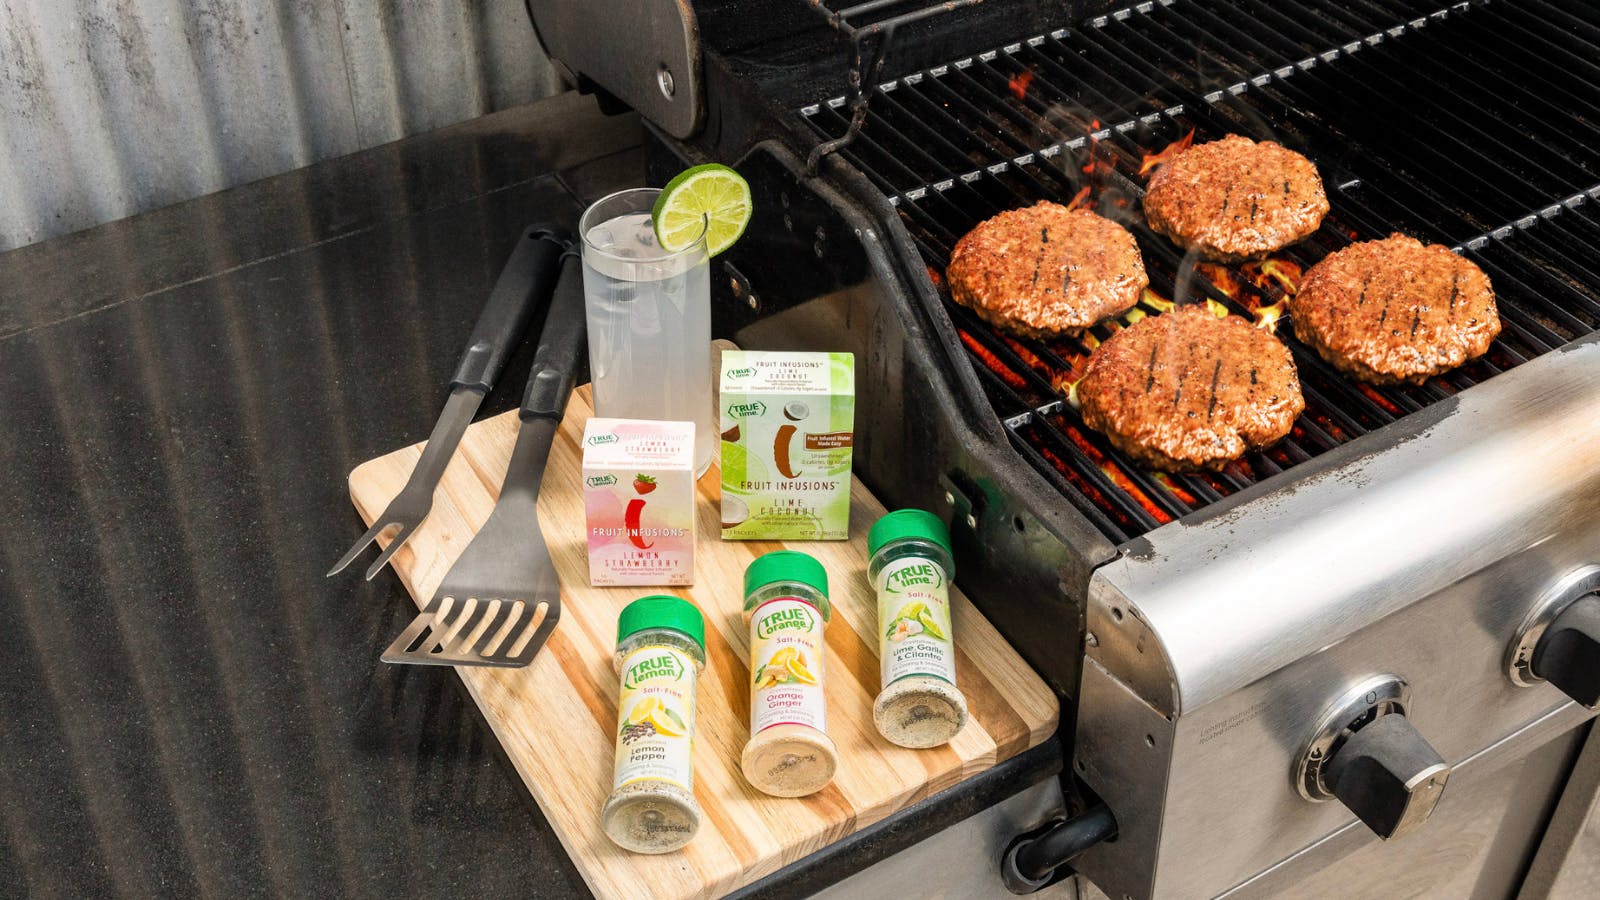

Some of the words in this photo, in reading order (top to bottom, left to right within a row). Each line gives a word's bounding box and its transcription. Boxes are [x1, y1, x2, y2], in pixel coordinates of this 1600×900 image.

[731, 368, 751, 376] TRUE
[734, 402, 760, 412] TRUE
[592, 474, 611, 482] TRUE
[740, 481, 772, 490] FRUIT
[776, 481, 836, 490] INFUSIONS
[774, 499, 802, 507] LIME
[760, 507, 816, 515] COCONUT
[593, 527, 623, 536] FRUIT
[627, 528, 684, 537] INFUSIONS
[623, 551, 659, 559] LEMON
[890, 564, 934, 582] TRUE
[901, 577, 930, 587] lime
[761, 608, 805, 627] TRUE
[766, 620, 807, 635] orange
[776, 637, 814, 649] Salt-Free
[917, 644, 944, 655] Garlic
[904, 651, 942, 661] Cilantro
[630, 655, 674, 678] TRUE
[633, 668, 675, 684] lemon
[643, 687, 682, 699] Salt-Free
[767, 691, 804, 702] Orange
[768, 699, 802, 709] Ginger
[631, 745, 665, 755] Lemon
[630, 753, 667, 763] Pepper
